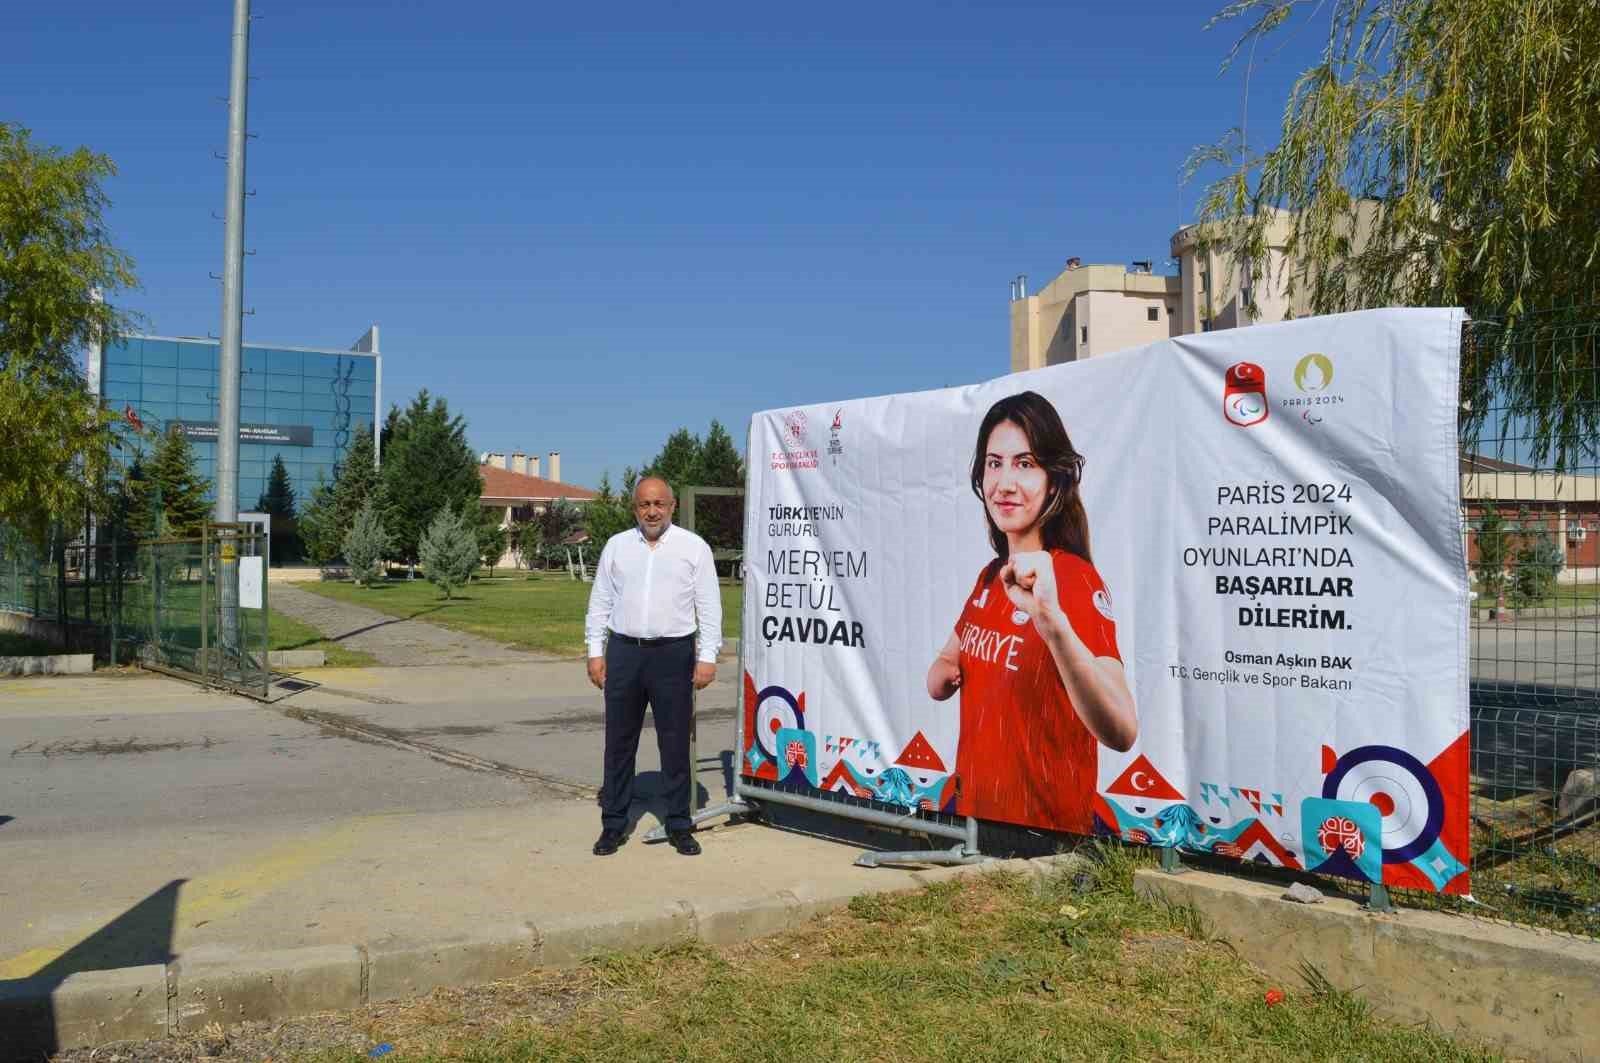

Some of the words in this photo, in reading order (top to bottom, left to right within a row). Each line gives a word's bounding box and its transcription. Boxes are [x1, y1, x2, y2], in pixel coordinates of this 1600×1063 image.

[1315, 393, 1344, 405] 2024
[1217, 480, 1285, 505] PARİS
[1292, 483, 1353, 504] 2024
[768, 502, 844, 521] TÜRKİYE'NİN
[1208, 511, 1354, 536] PARALİMPİK
[767, 550, 867, 578] MERYEM
[1183, 547, 1354, 568] OYUNLARI'NDA
[765, 577, 841, 612] BETÜL
[1215, 575, 1354, 600] BAŞARILAR
[1238, 602, 1353, 630] DİLERİM.
[761, 614, 866, 649] ÇAVDAR
[1224, 650, 1273, 666] Osman
[1275, 653, 1317, 670] Aşkın
[1320, 656, 1353, 670] BAK
[1168, 666, 1190, 679] T.C.
[1192, 669, 1240, 685] Gençlik
[1243, 674, 1259, 684] ve
[1262, 674, 1296, 688] Spor
[1300, 674, 1353, 691] Bakanı
